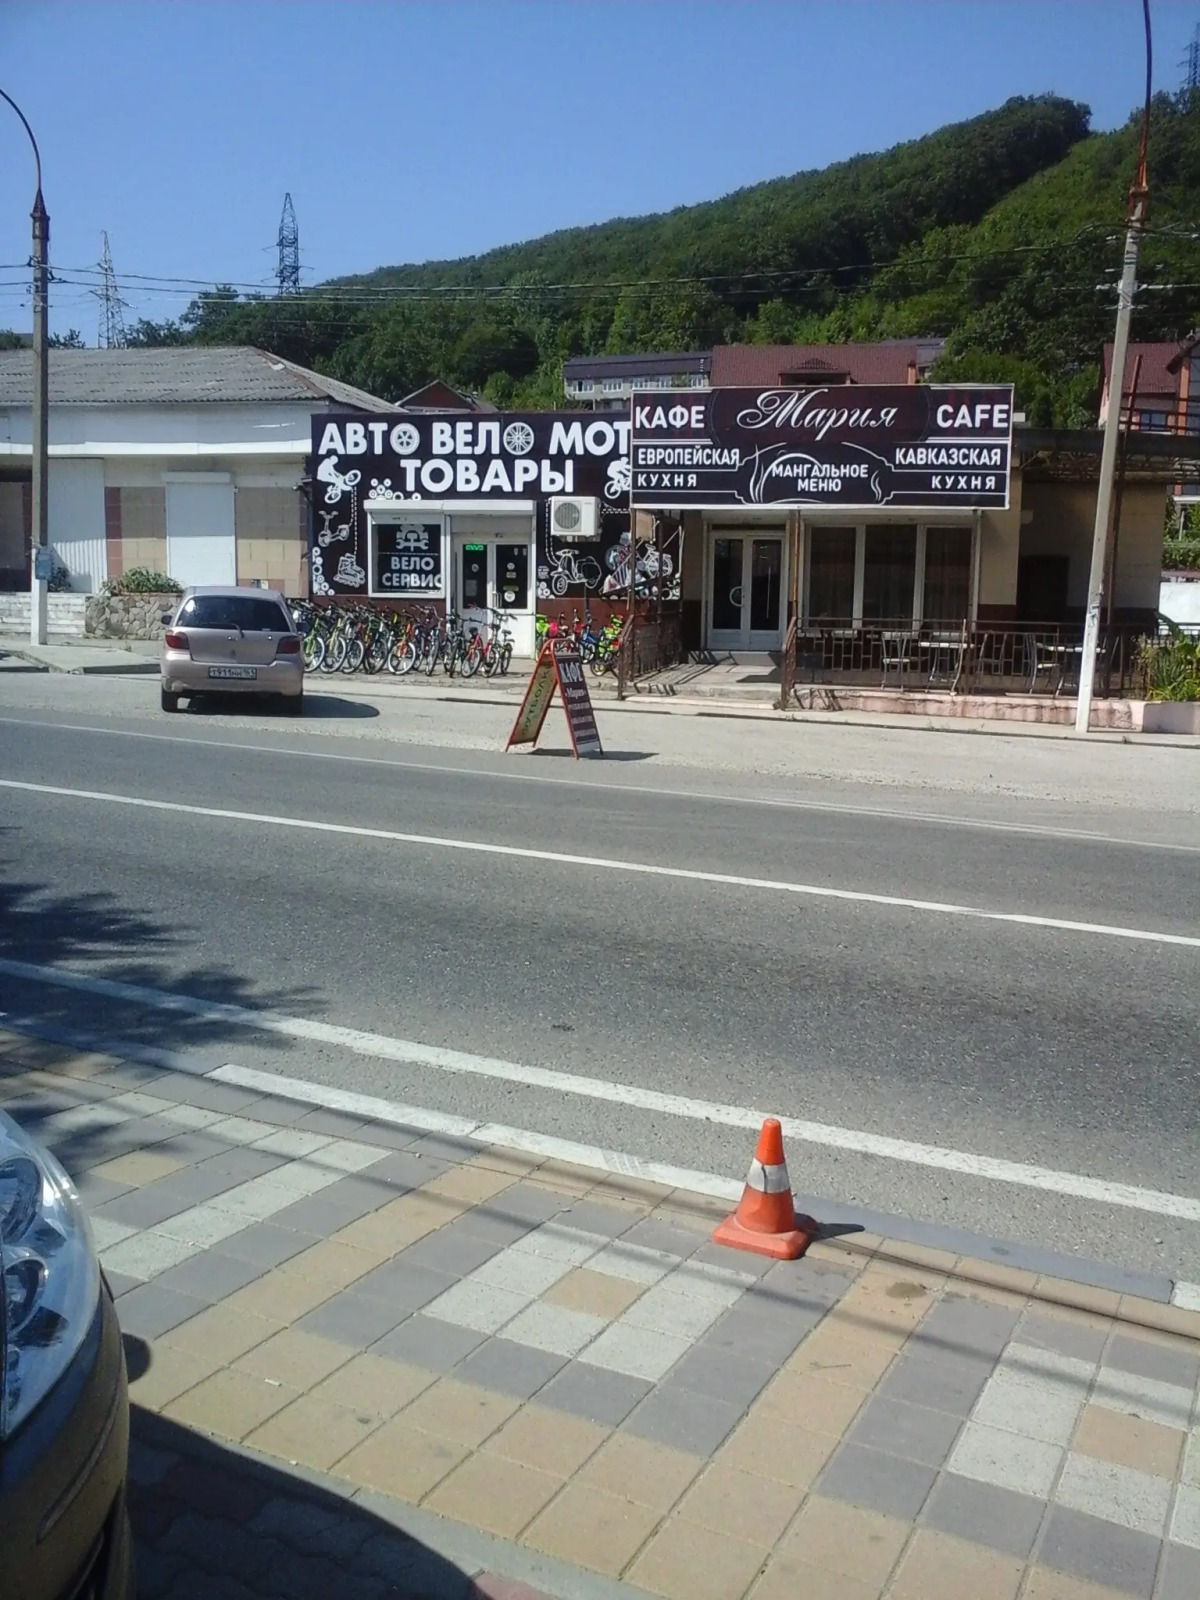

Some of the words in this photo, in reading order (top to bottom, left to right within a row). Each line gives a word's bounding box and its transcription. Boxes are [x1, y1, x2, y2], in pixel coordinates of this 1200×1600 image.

[635, 405, 706, 429] КАФЕ
[736, 389, 898, 440] Мария
[936, 404, 1009, 428] CAFE
[637, 447, 740, 466] ЕВРОПЕЙСКАЯ
[895, 448, 1002, 466] КАВКАЗСКАЯ
[400, 459, 574, 493] ТОВАРЫ
[772, 463, 869, 478] МАНГАЛЬНОЕ
[637, 473, 698, 488] КУХНЯ
[797, 479, 842, 493] МЕНЮ
[931, 475, 997, 491] КУХНЯ
[391, 556, 434, 571] ВЕЛО
[382, 572, 442, 588] СЕРВИС
